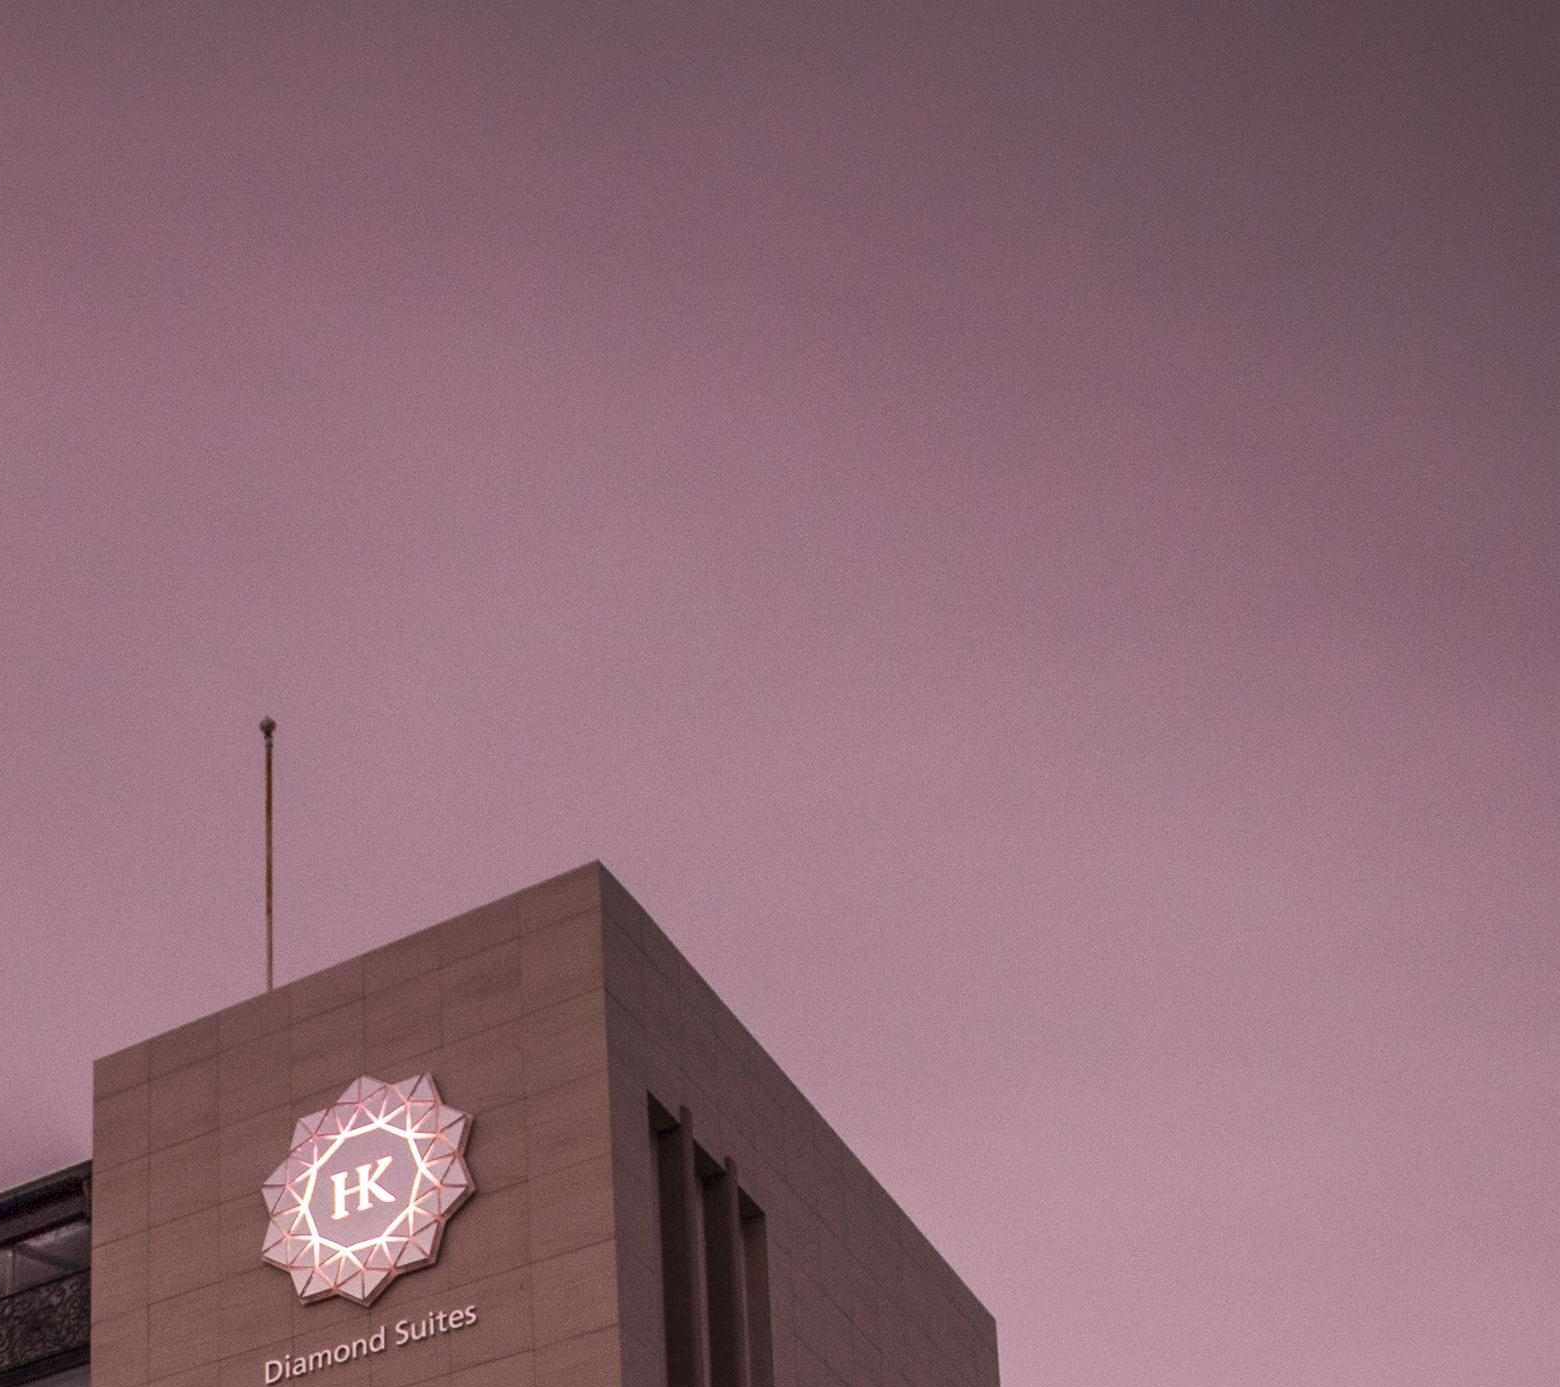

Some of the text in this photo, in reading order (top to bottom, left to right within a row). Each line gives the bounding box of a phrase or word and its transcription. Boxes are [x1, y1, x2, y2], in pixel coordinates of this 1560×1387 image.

[330, 1156, 396, 1220] HK
[264, 1305, 479, 1386] Diamond Suites
